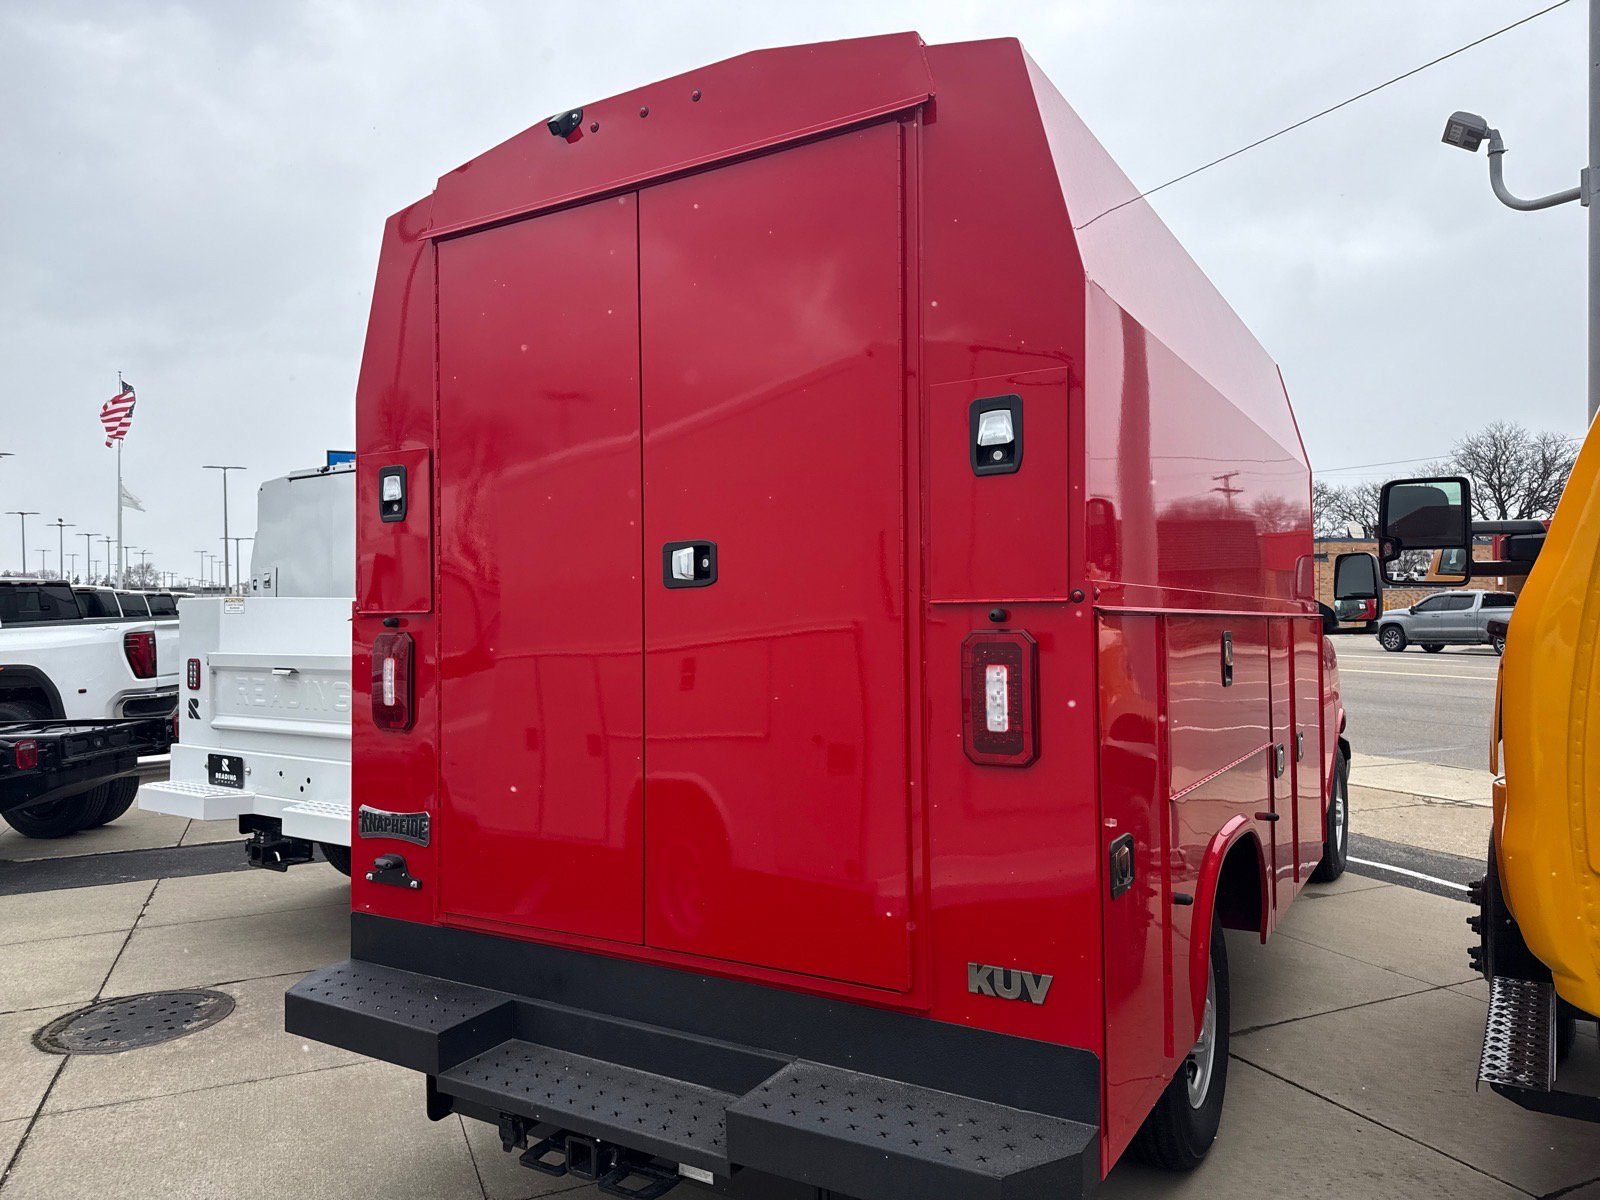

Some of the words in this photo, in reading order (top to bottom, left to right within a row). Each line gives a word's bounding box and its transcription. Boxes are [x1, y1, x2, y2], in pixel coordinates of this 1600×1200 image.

[235, 676, 351, 713] READING
[215, 772, 237, 781] READING
[361, 809, 428, 840] KNAPHEIDE
[967, 962, 1053, 1005] KUV
